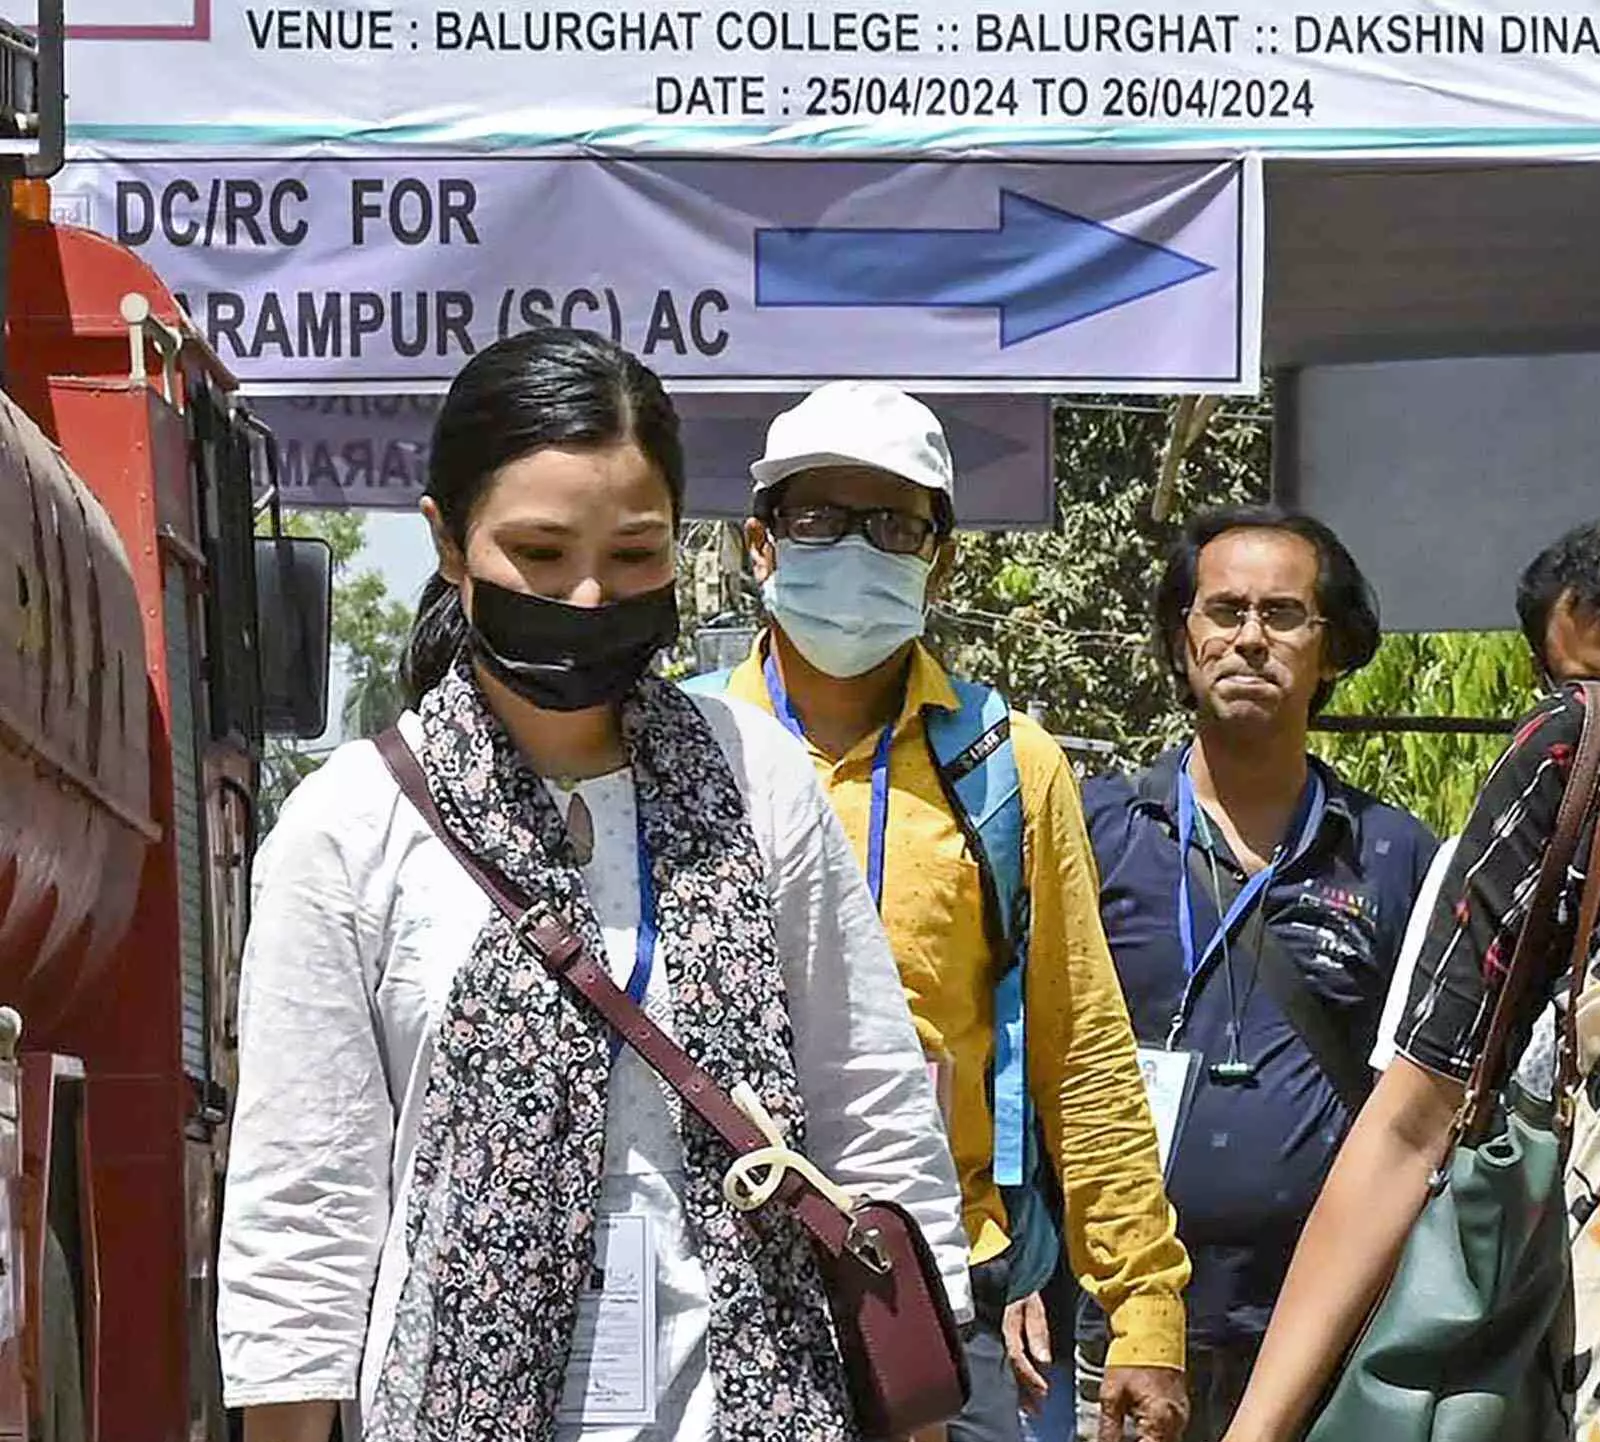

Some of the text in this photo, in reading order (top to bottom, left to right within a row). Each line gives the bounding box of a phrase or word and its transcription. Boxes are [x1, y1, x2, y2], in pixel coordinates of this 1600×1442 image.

[246, 10, 393, 50] VENUE
[411, 21, 418, 50] :
[436, 11, 702, 51] BALURGHAT
[716, 11, 919, 52] COLLEGE
[976, 13, 1239, 53] BALURGHAT
[1295, 14, 1483, 54] DAKSHIN
[656, 76, 1314, 118] DATE : 25/04/2024 TO 26/04/2024
[116, 178, 480, 247] DC/RC FOR
[174, 288, 730, 358] RAMPUR (SC) AC
